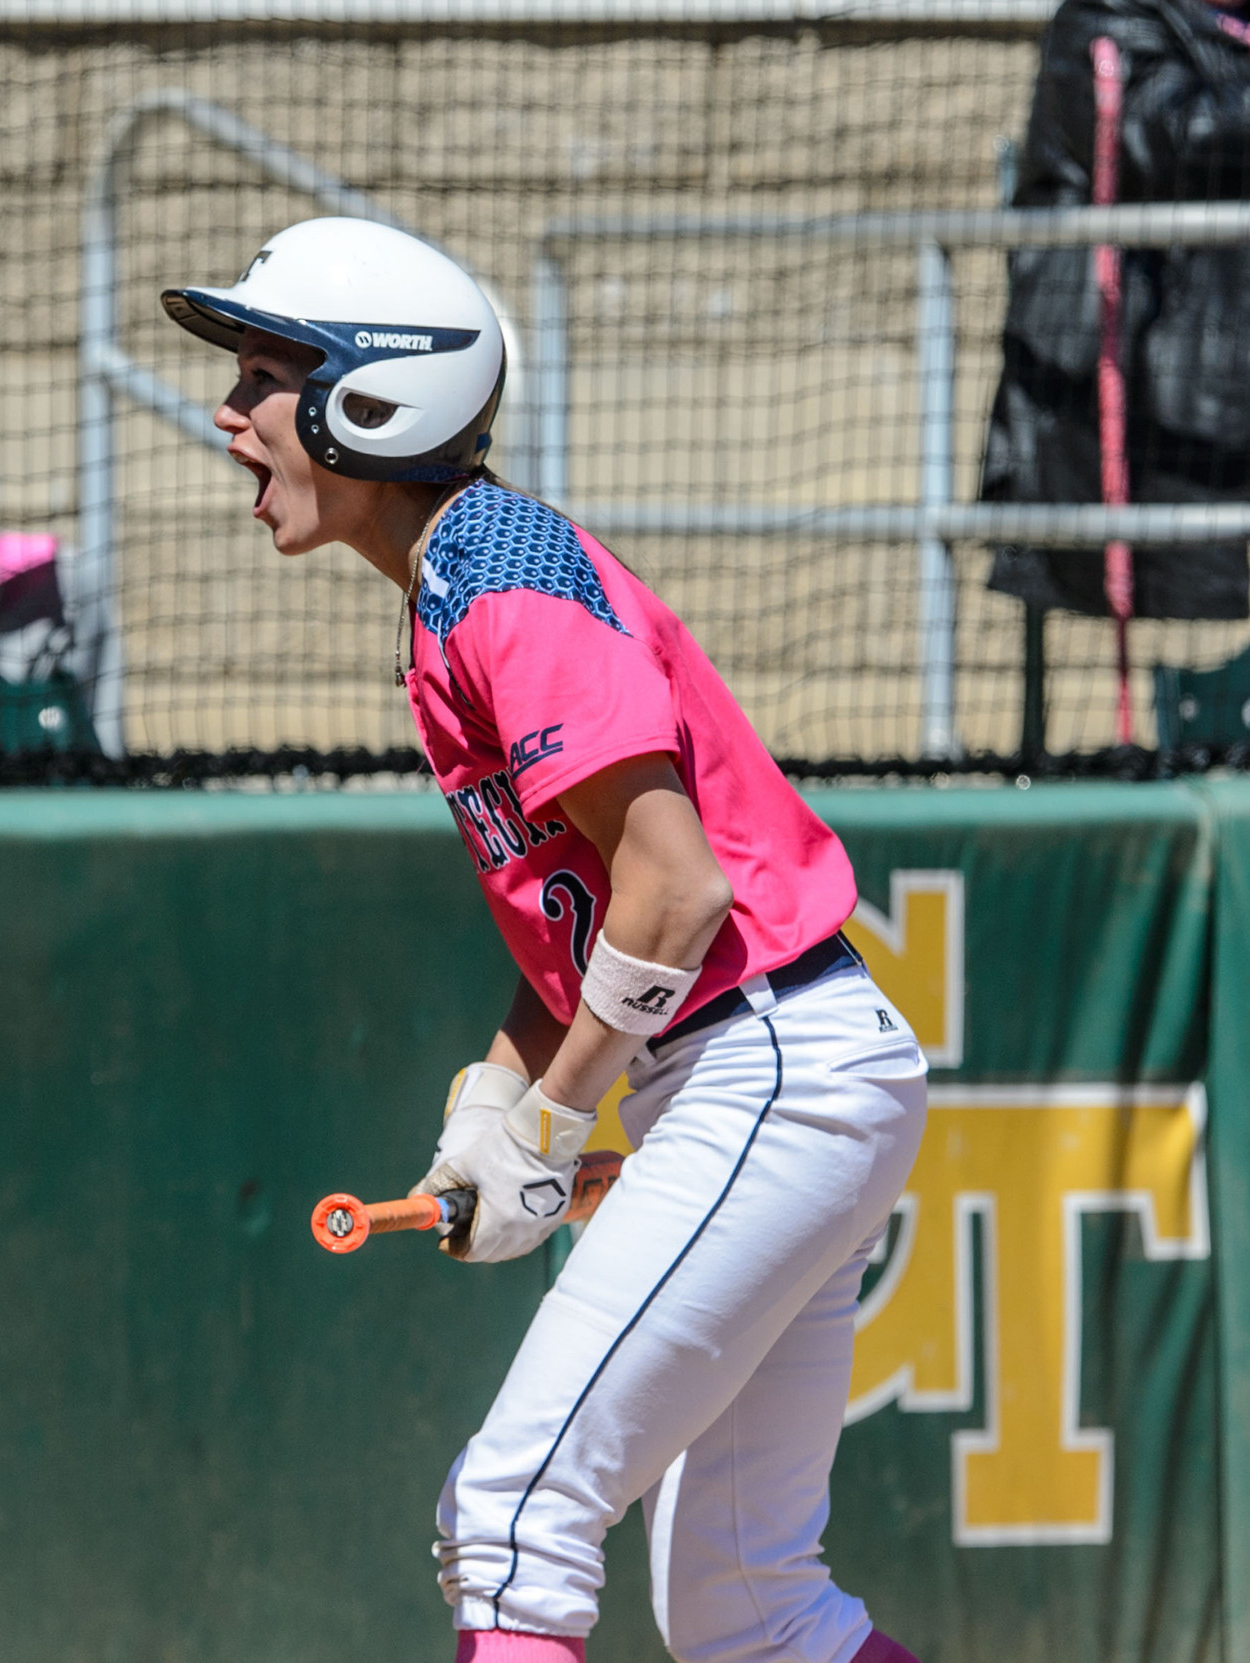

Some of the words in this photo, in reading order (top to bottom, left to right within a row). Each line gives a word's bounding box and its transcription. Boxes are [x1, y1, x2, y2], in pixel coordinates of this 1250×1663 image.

[372, 331, 434, 351] WORTH
[508, 723, 564, 774] ACC
[621, 996, 669, 1016] RUSSELL
[636, 985, 676, 1009] R
[875, 1008, 893, 1027] R
